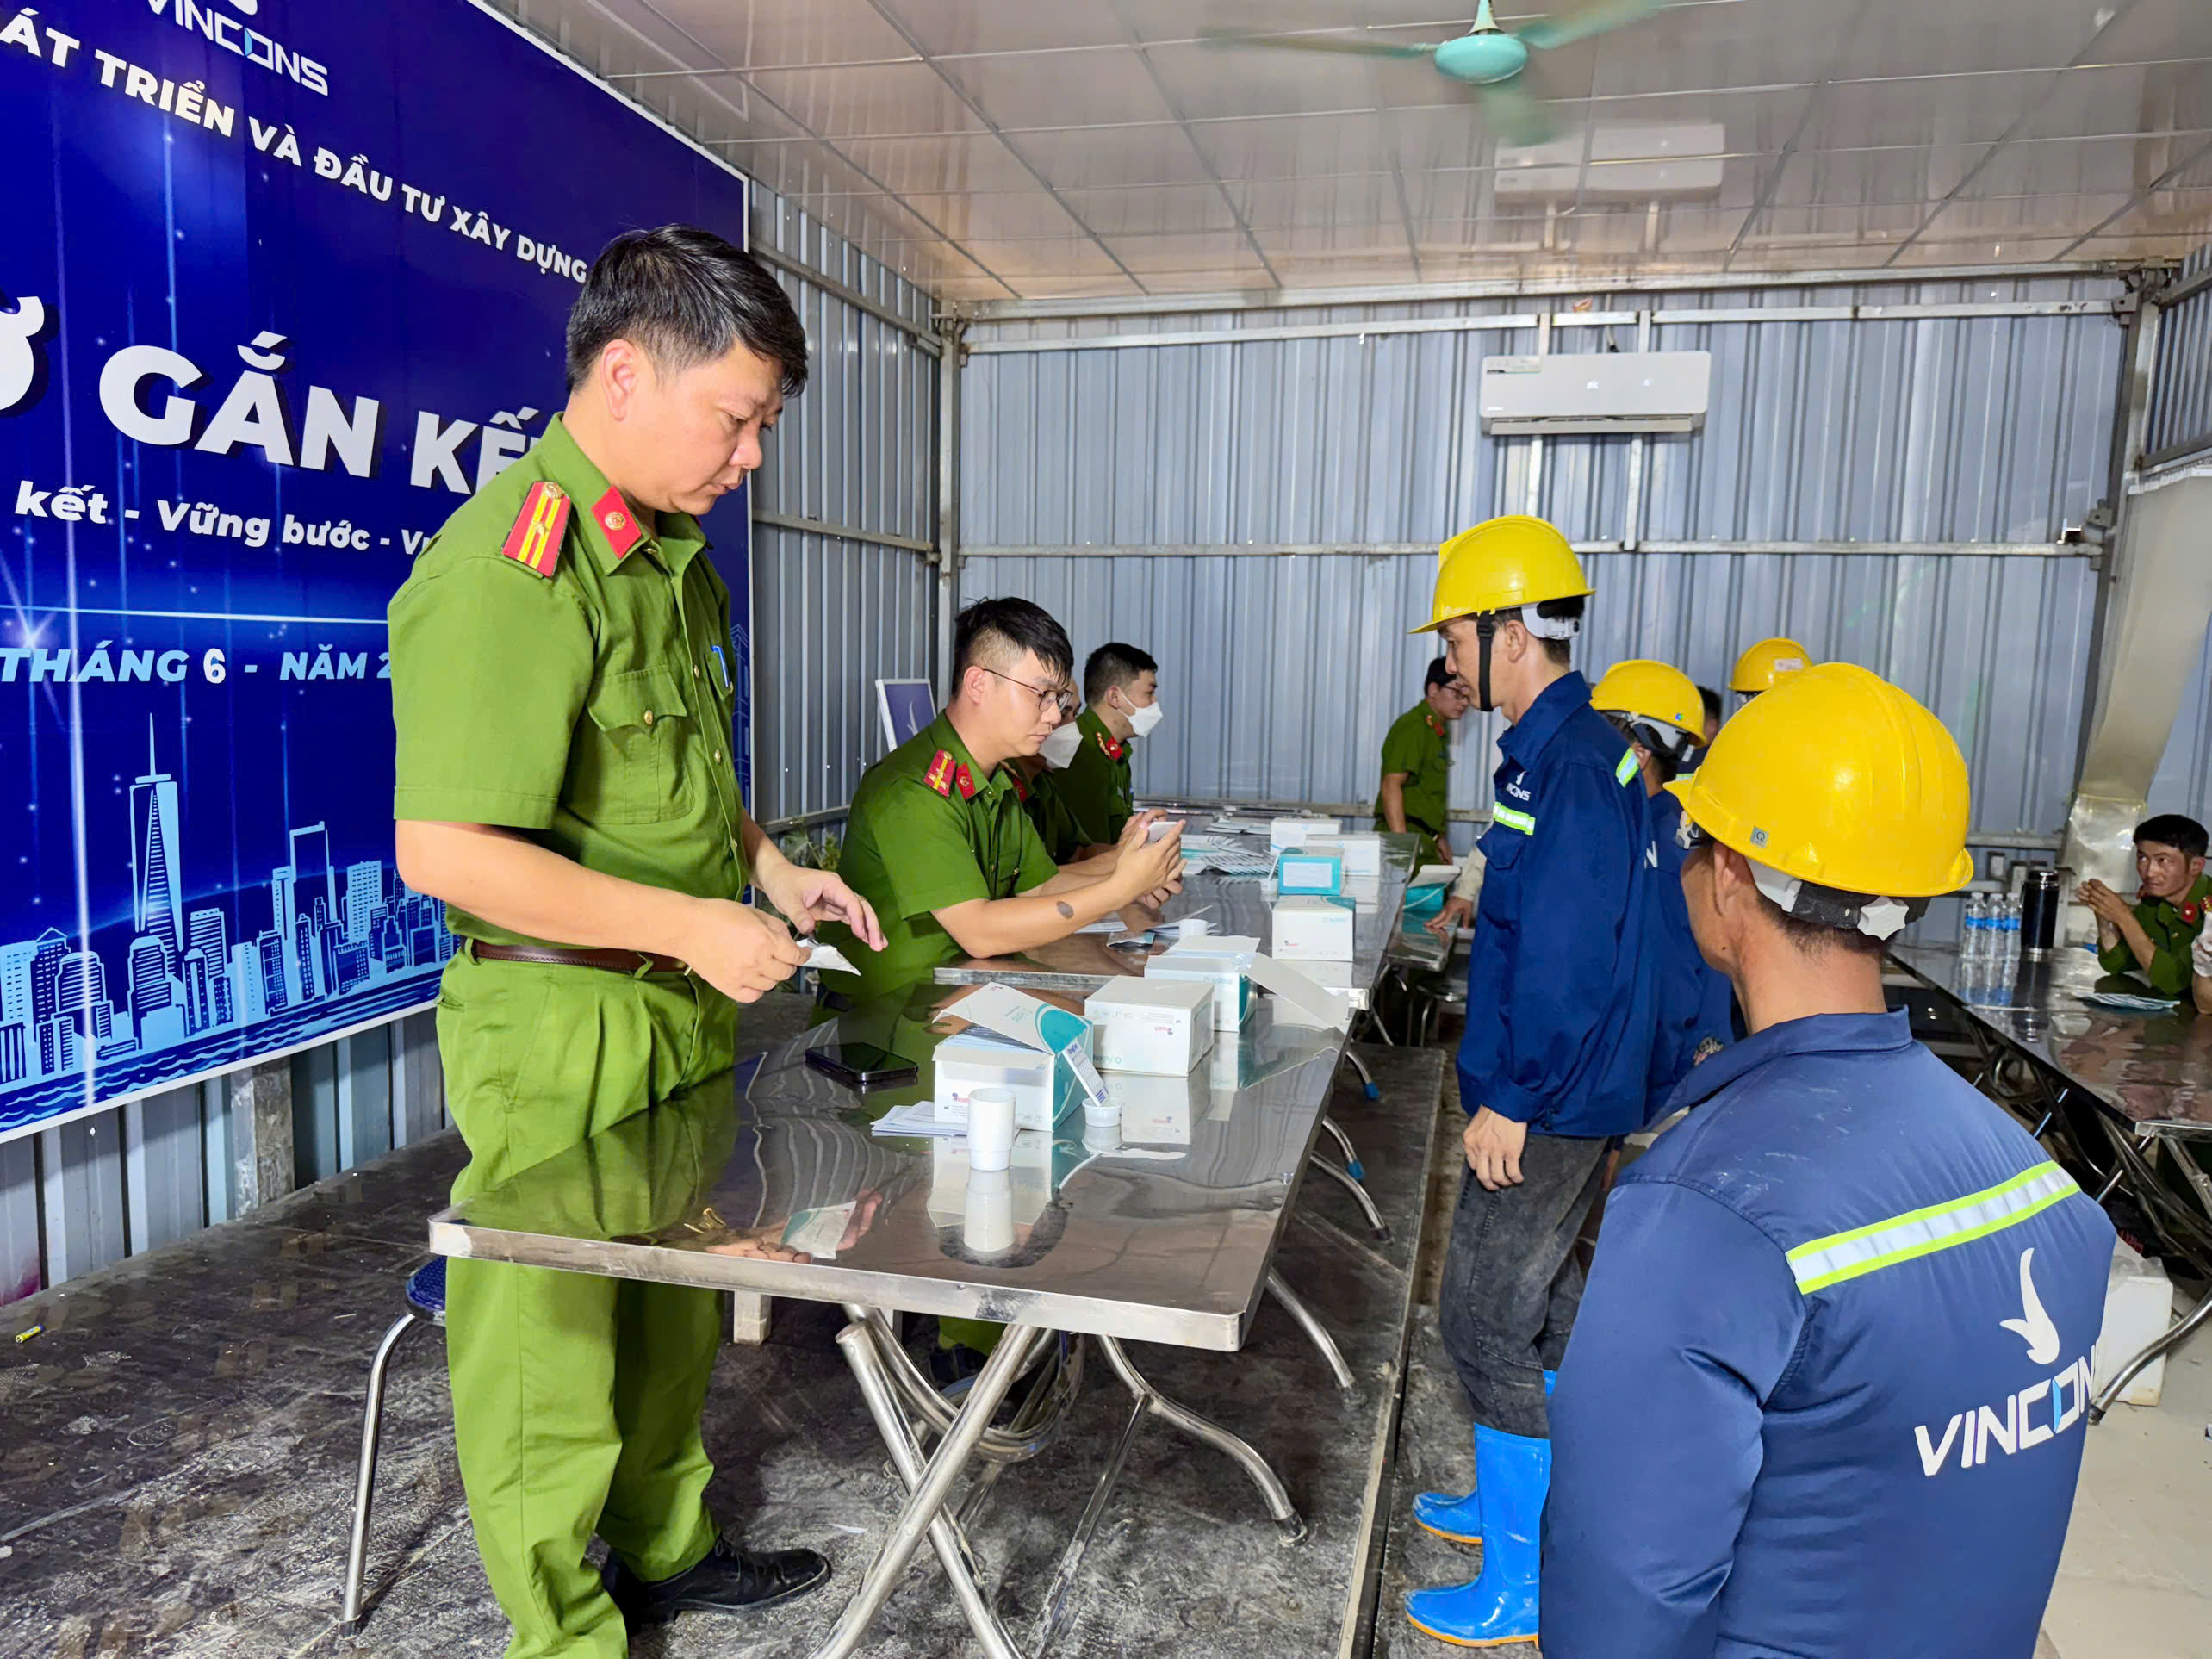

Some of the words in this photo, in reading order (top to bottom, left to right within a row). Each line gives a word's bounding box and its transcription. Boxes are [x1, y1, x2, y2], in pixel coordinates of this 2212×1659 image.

[95, 48, 235, 137] TRIỂN
[248, 115, 301, 167] VÀ
[314, 146, 393, 202] ĐẦU
[401, 183, 446, 222] TƯ
[450, 205, 511, 251] XÂY
[517, 234, 587, 283] DỰNG
[99, 330, 379, 478] GẮN
[410, 407, 541, 495] KẾ
[15, 480, 109, 524] kết
[157, 500, 270, 549] Vững
[282, 514, 370, 550] bước
[0, 640, 190, 683] THÁNG
[203, 648, 226, 684] 6
[279, 643, 368, 680] NĂM
